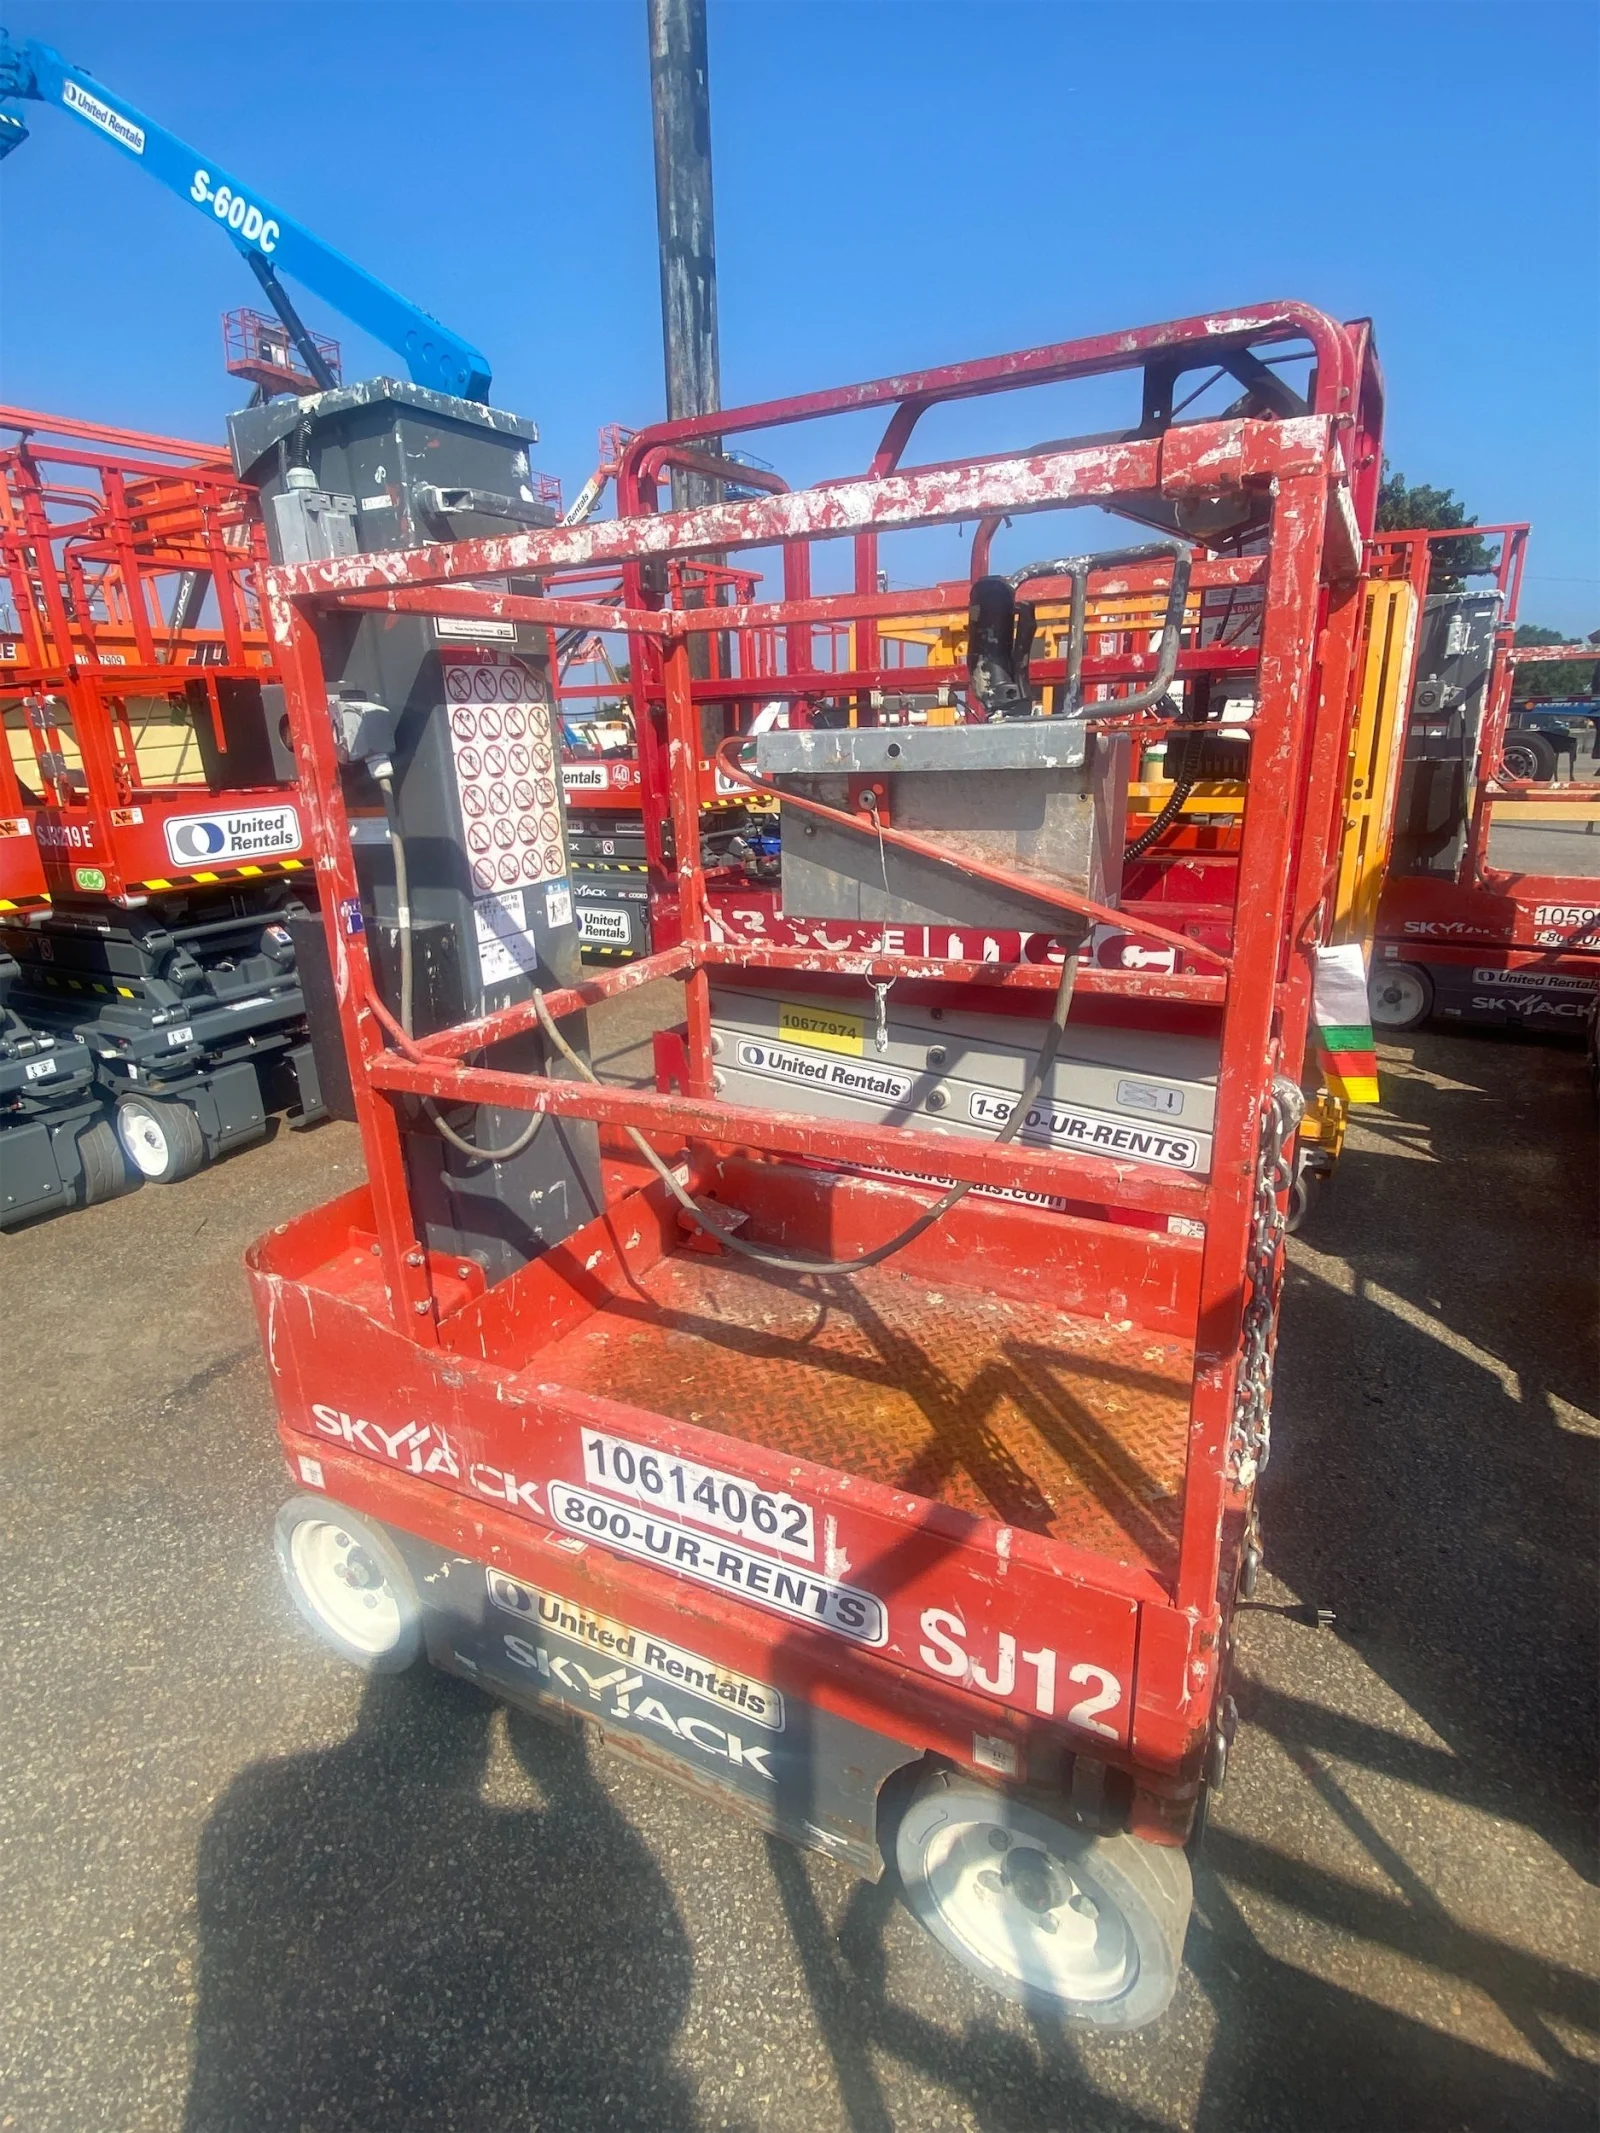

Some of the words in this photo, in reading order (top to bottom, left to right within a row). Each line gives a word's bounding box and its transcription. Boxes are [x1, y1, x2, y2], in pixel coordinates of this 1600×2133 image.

[77, 92, 109, 123] United
[108, 114, 142, 148] Rentals
[190, 169, 280, 253] S-60DC
[566, 493, 589, 523] Rentals
[562, 770, 602, 784] entals
[227, 815, 285, 836] United
[230, 831, 294, 852] Rentals
[573, 884, 607, 897] YJACK
[584, 913, 621, 927] United
[585, 925, 626, 939] Rentals
[1538, 907, 1600, 927] 1059
[1498, 972, 1546, 987] United
[1471, 993, 1594, 1018] SKYJACK
[782, 1014, 857, 1040] 10677974
[768, 1052, 828, 1080] United
[831, 1066, 902, 1097] Rentals
[976, 1099, 1190, 1161] 1-80-UR-RENTS
[311, 1403, 546, 1516] SKYJACK
[588, 1438, 809, 1548] 10614062
[564, 1497, 866, 1628] 800-UR-RENTS
[538, 1597, 636, 1658] United
[643, 1642, 767, 1716] Rentals
[919, 1607, 1122, 1741] SJ12
[502, 1633, 780, 1783] SKYJACK
